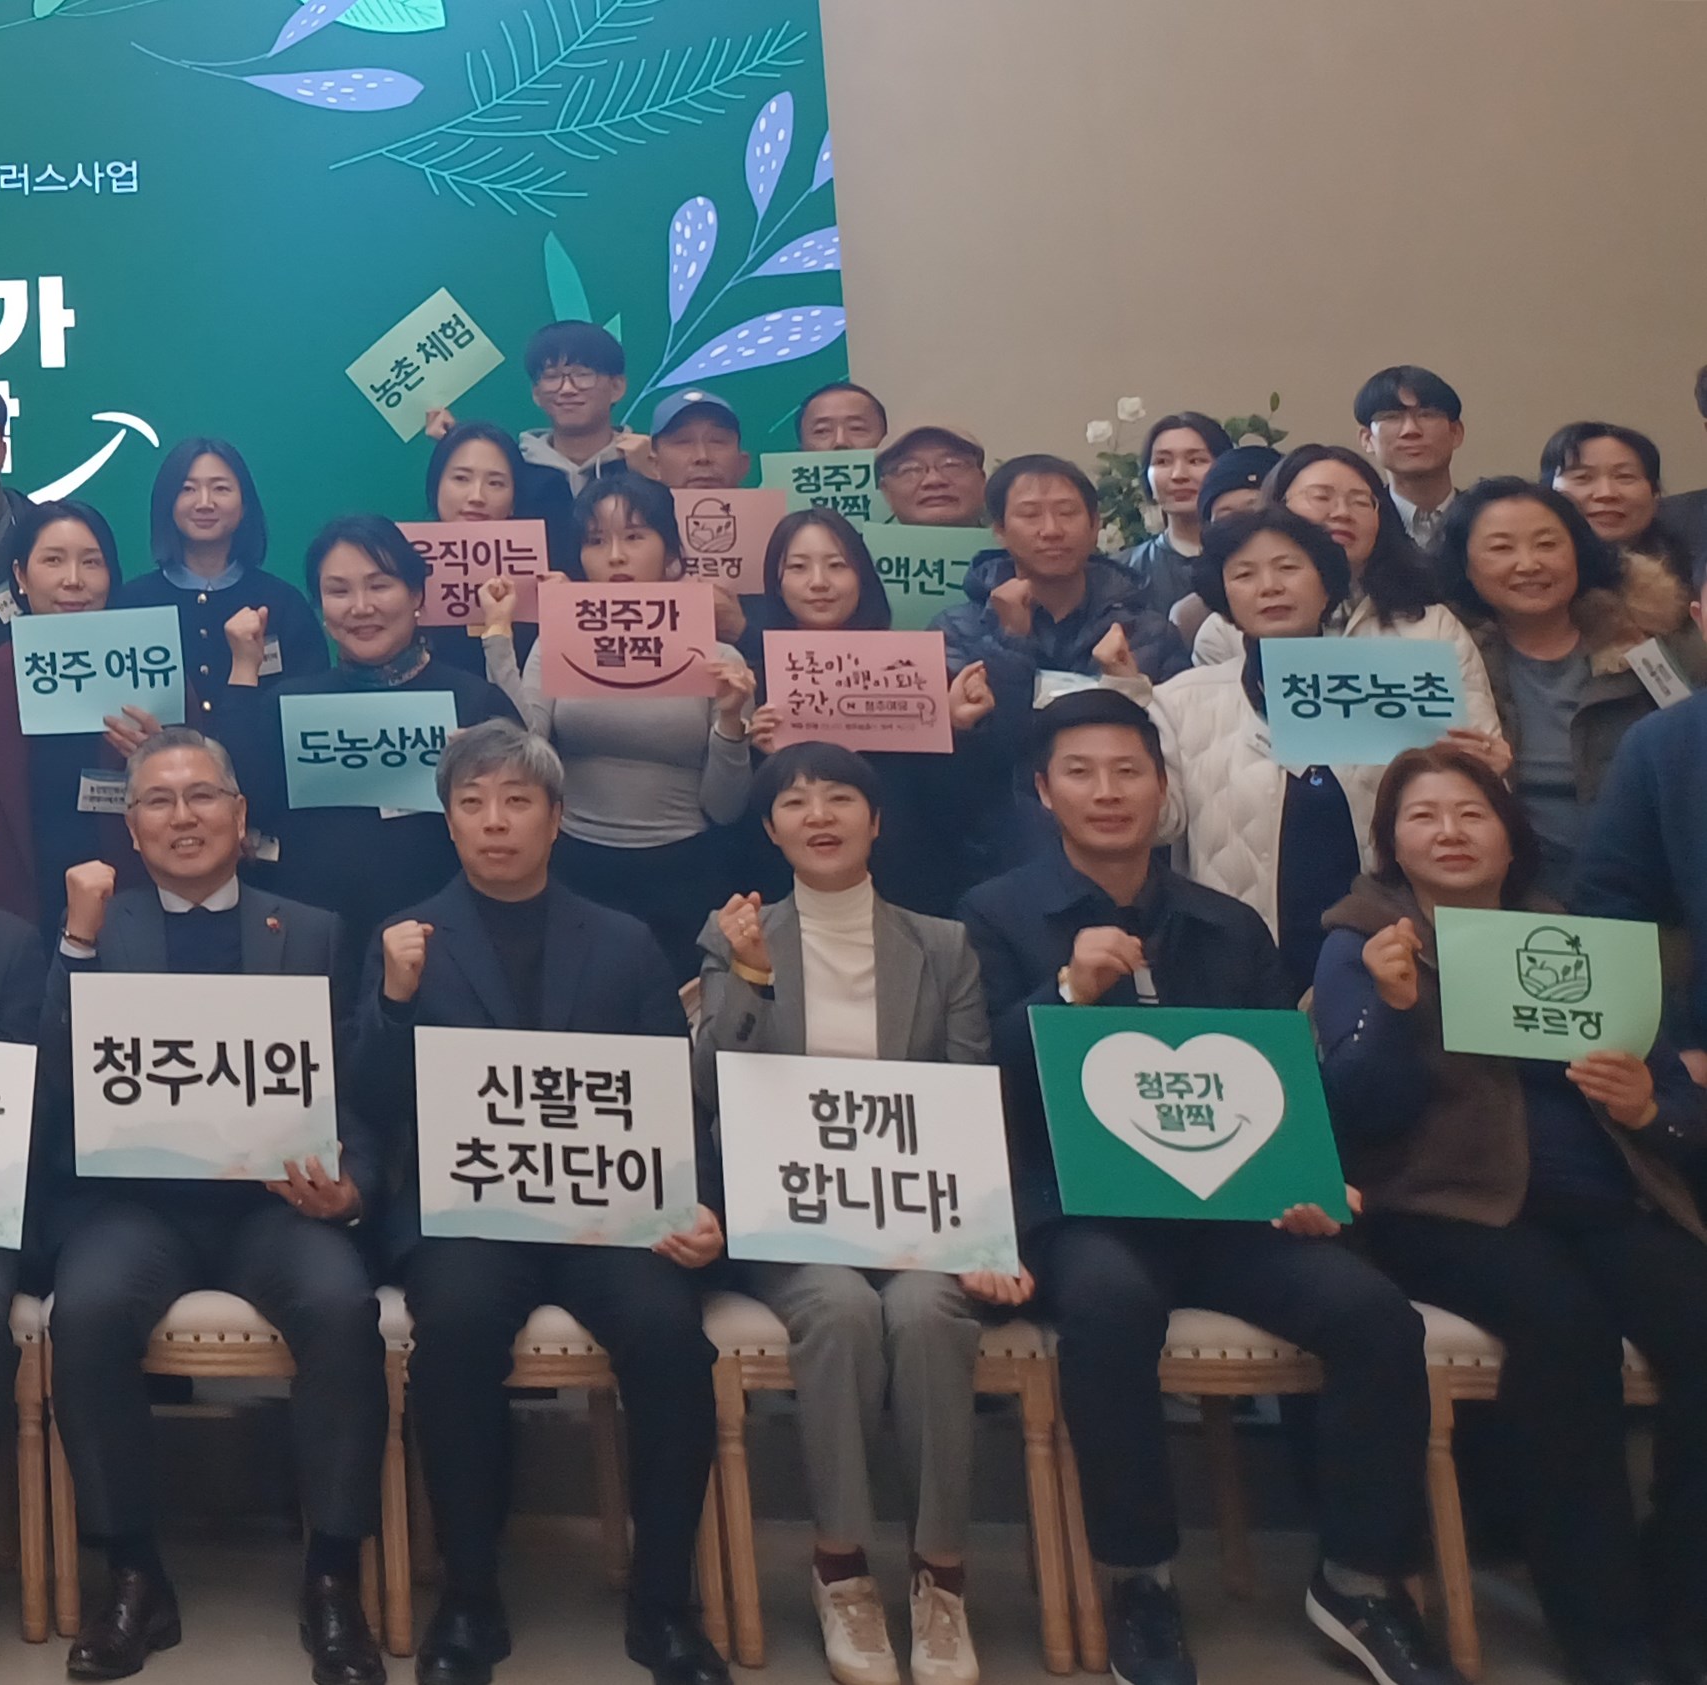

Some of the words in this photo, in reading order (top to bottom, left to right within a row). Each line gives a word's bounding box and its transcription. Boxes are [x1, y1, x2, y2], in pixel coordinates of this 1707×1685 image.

[369, 356, 425, 409] 농촌
[415, 312, 475, 364] 체험
[575, 599, 680, 633] 청주가
[23, 649, 96, 694] 청주
[104, 644, 178, 689] 여유
[593, 635, 665, 668] 활짝
[1281, 672, 1455, 718] 청주농촌
[297, 726, 446, 768] 도농상생
[1512, 1005, 1603, 1040] 푸르장
[92, 1036, 319, 1107] 청주시와
[1134, 1070, 1224, 1102] 청주가
[477, 1064, 634, 1131] 신활력
[1155, 1103, 1216, 1132] 활짝
[808, 1088, 918, 1156] 함께
[449, 1137, 665, 1210] 추진단이
[778, 1160, 961, 1233] 합니다!
